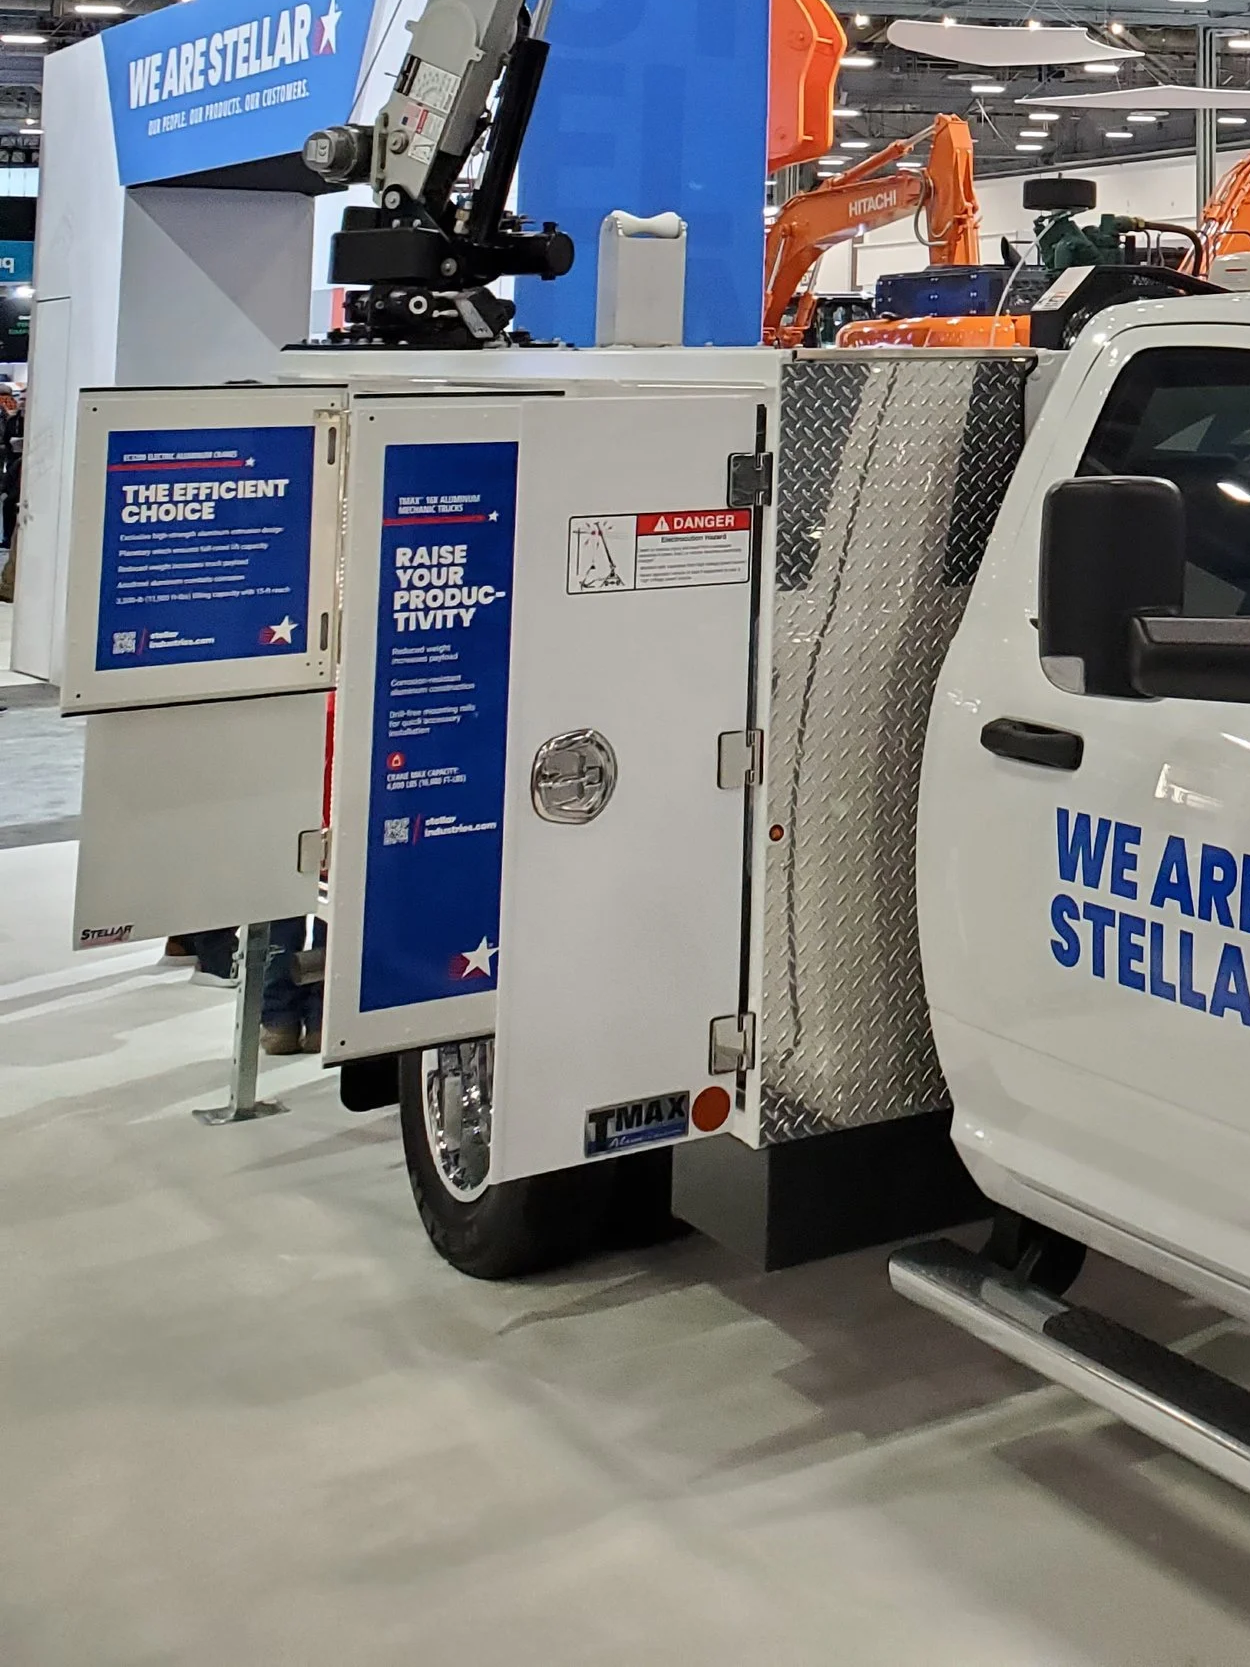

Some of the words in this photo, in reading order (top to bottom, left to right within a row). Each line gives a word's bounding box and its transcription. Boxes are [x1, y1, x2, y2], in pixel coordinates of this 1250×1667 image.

[129, 52, 162, 109] WE
[162, 38, 208, 100] ARE
[208, 3, 312, 86] STELLAR
[148, 118, 161, 136] OUR
[163, 111, 187, 132] PEOPLE.
[189, 106, 203, 125] OUR
[205, 97, 242, 121] PRODUCTS.
[245, 92, 260, 111] OUR
[262, 79, 309, 107] CUSTOMERS.
[849, 190, 897, 217] HITACHI
[122, 484, 170, 504] THE
[173, 479, 289, 502] EFFICIENT
[121, 502, 216, 524] CHOICE
[673, 515, 735, 530] DANGER
[395, 544, 468, 567] RAISE
[396, 566, 464, 588] YOUR
[393, 585, 506, 610] PRODUC-
[393, 607, 476, 632] TIVITY
[1056, 806, 1142, 901] WE
[80, 924, 135, 941] STELLAR
[588, 1094, 687, 1152] TMAX
